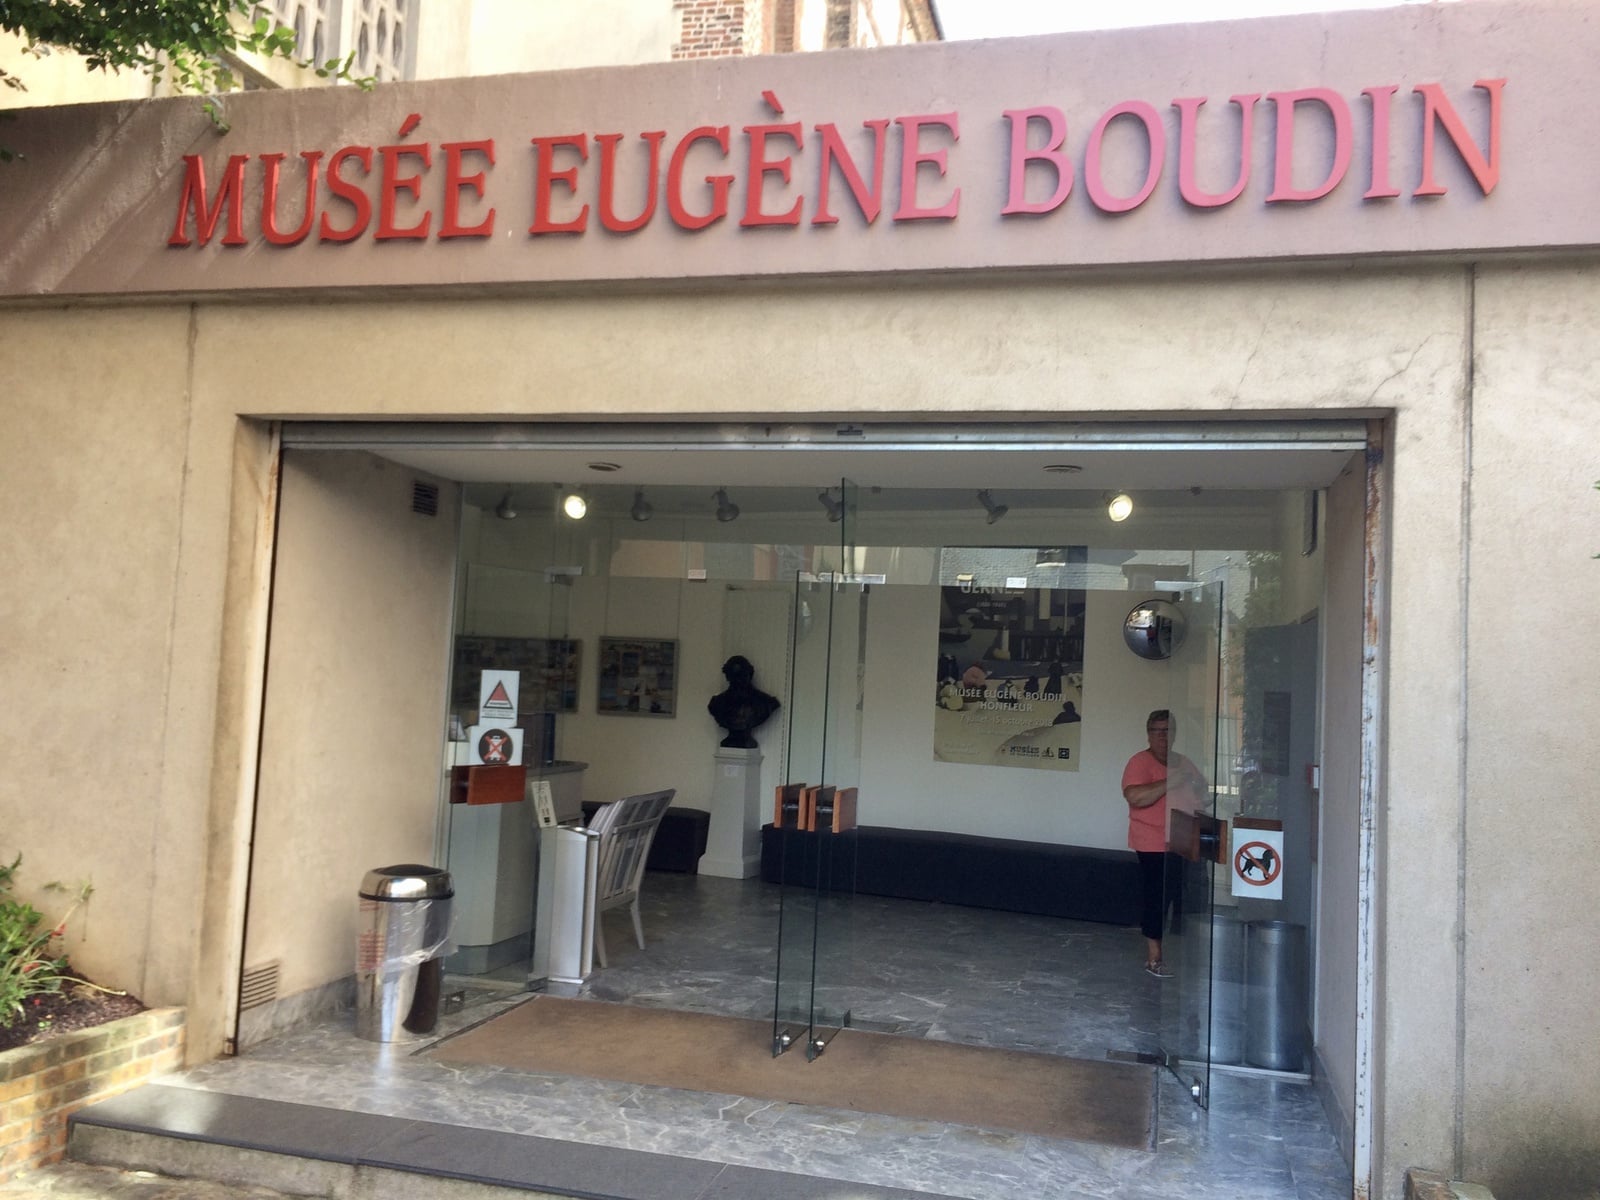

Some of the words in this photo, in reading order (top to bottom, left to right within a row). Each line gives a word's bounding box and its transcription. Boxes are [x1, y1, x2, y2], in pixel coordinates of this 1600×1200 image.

[167, 112, 496, 248] MUSÉE
[529, 90, 962, 235] EUGÈNE
[1002, 78, 1509, 217] BOUDIN
[950, 687, 982, 698] MUSÉE
[984, 688, 1023, 700] EUGÈNE
[1025, 691, 1067, 703] BOUDIN
[979, 701, 1033, 713] HONFLEUR
